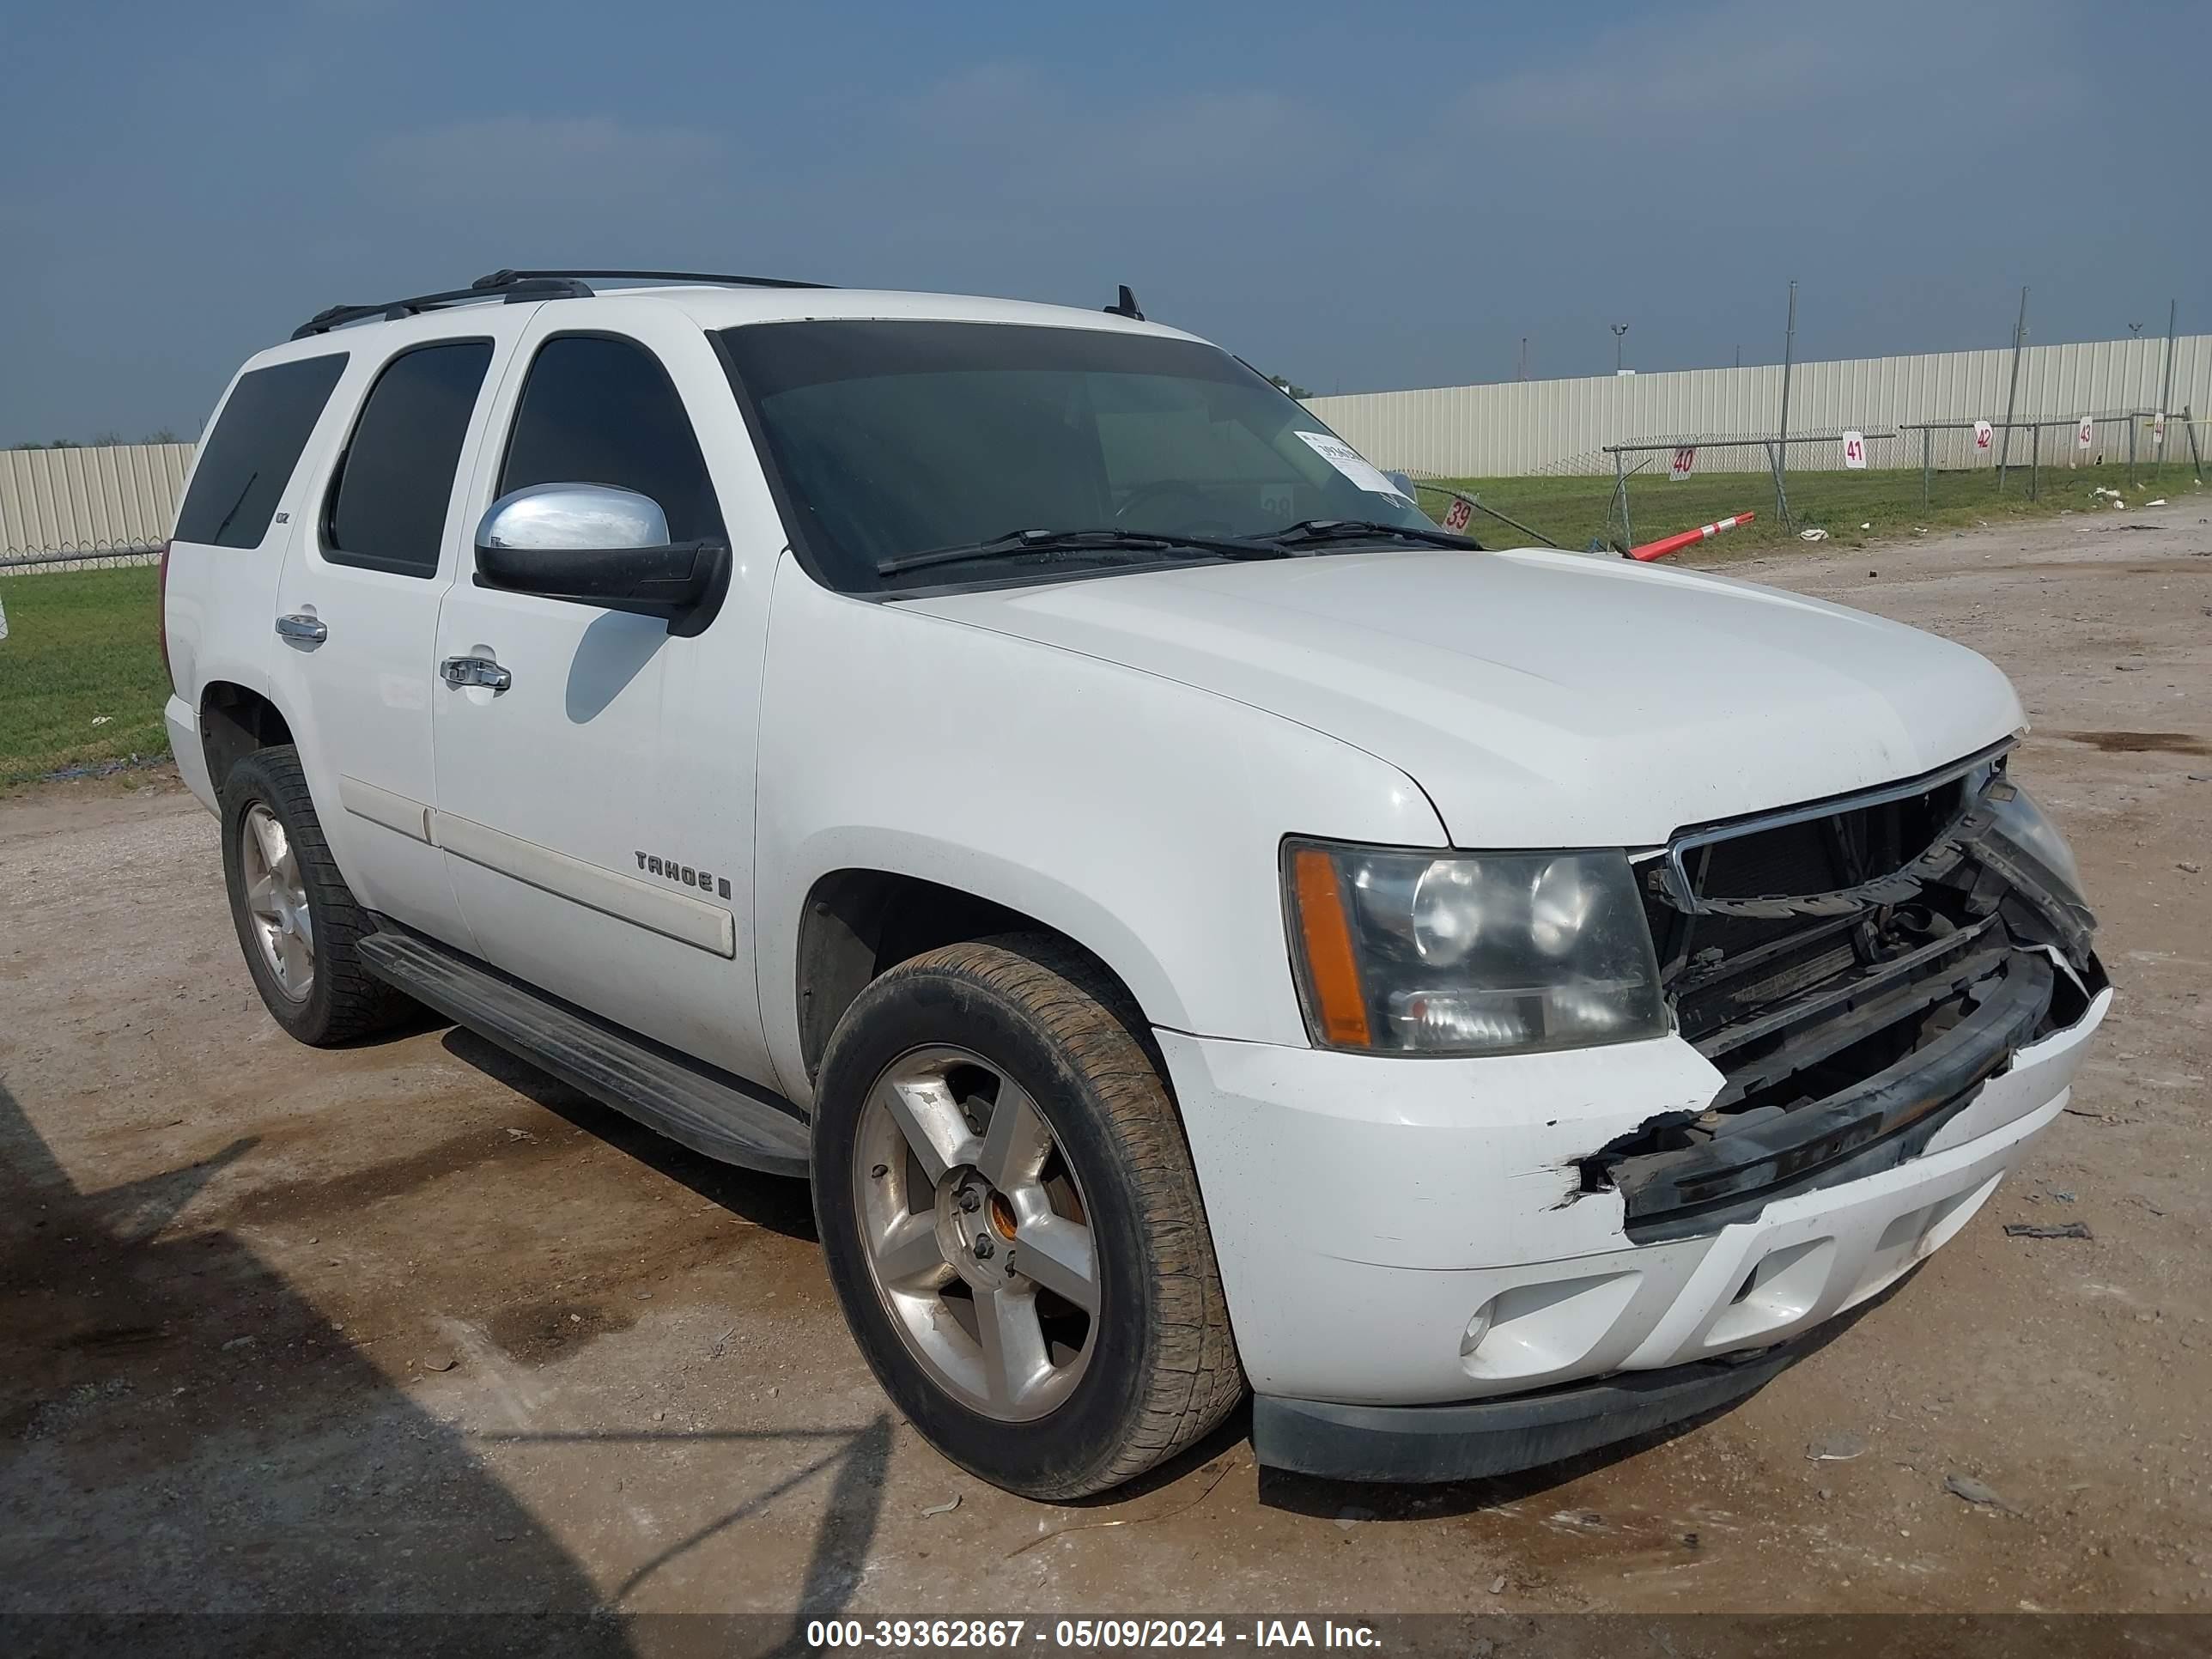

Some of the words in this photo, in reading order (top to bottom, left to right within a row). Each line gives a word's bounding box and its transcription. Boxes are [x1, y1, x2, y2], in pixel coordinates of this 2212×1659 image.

[1978, 428, 1991, 448] 42
[2081, 424, 2091, 442] 43
[1674, 449, 1693, 473] 40
[1847, 440, 1863, 461] 41
[1446, 501, 1471, 530] 39
[634, 850, 714, 892] TAHOE
